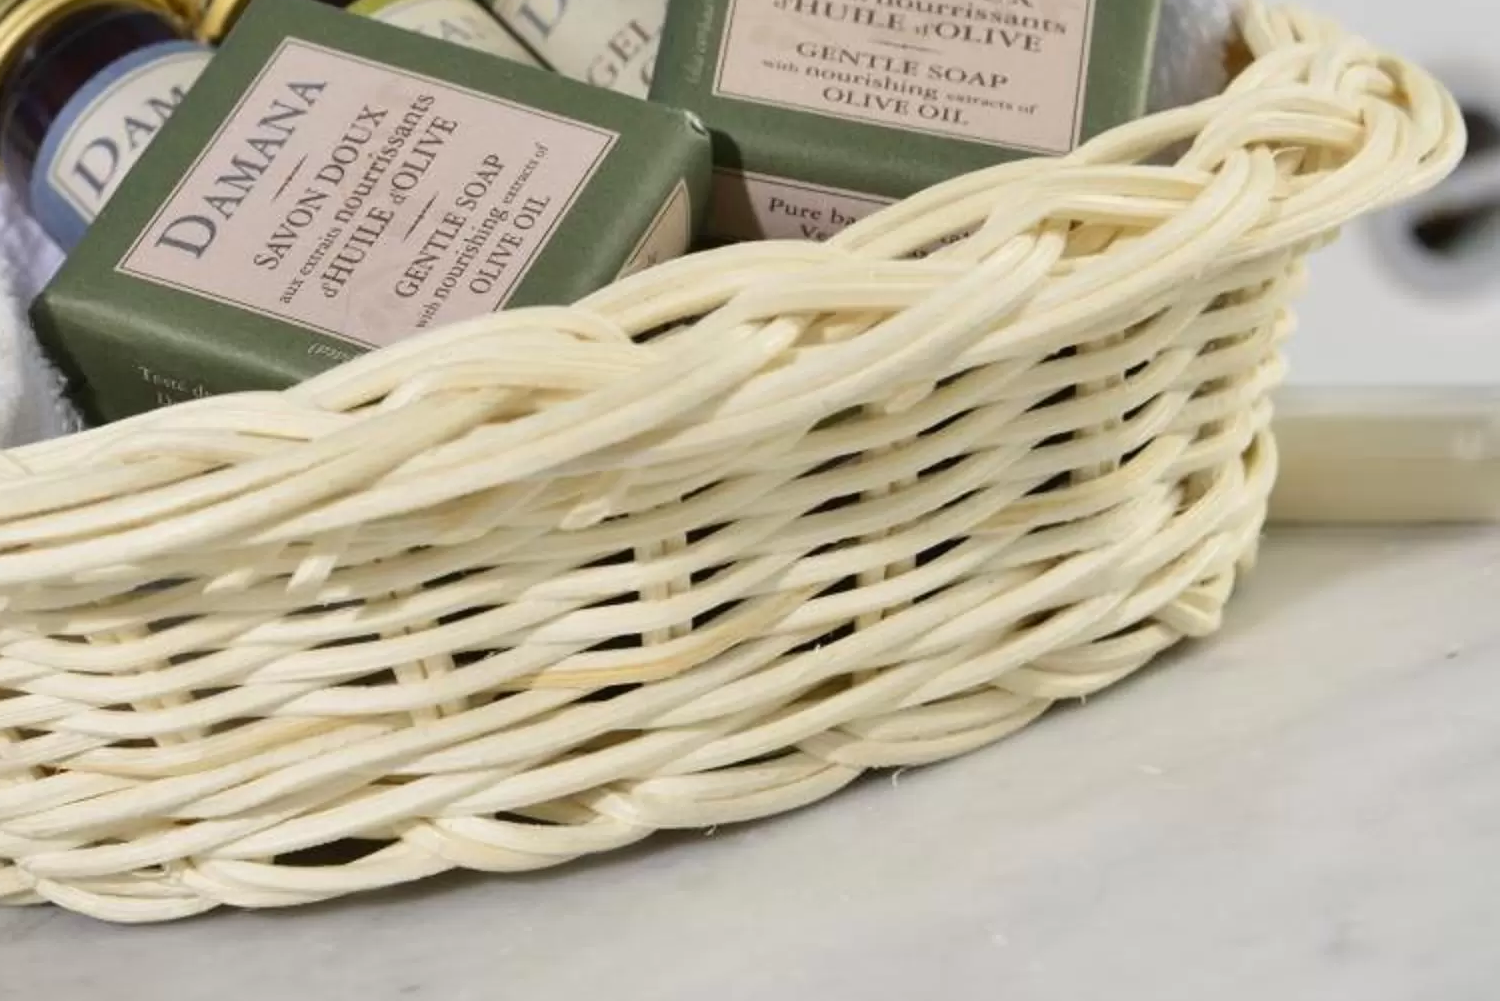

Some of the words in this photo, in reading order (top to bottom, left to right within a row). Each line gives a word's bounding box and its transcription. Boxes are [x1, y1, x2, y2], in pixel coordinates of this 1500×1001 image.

[761, 58, 799, 74] with
[805, 65, 939, 101] nourishing
[946, 93, 1013, 112] extracts
[1018, 104, 1038, 116] of
[796, 42, 919, 76] GENTLE
[928, 64, 1009, 89] SOAP
[915, 21, 1042, 53] d'OLIVE
[822, 86, 909, 116] OLIVE
[918, 103, 969, 125] OIL
[154, 81, 328, 259] DAMANA
[253, 187, 329, 271] SAVON
[316, 104, 389, 187] DOUX
[279, 276, 304, 304] aux
[300, 225, 343, 278] extraits
[334, 93, 436, 225] nourrissants
[321, 206, 395, 299] d'HUILE
[389, 116, 459, 205] d'OLIVE
[395, 212, 466, 298] GENTLE
[455, 153, 505, 212] SOAP
[768, 197, 822, 221] Pure
[415, 301, 439, 328] with
[434, 206, 509, 301] nourishing
[503, 157, 539, 205] extracts
[534, 141, 549, 159] of
[469, 233, 523, 295] OLIVE
[513, 196, 551, 231] OIL
